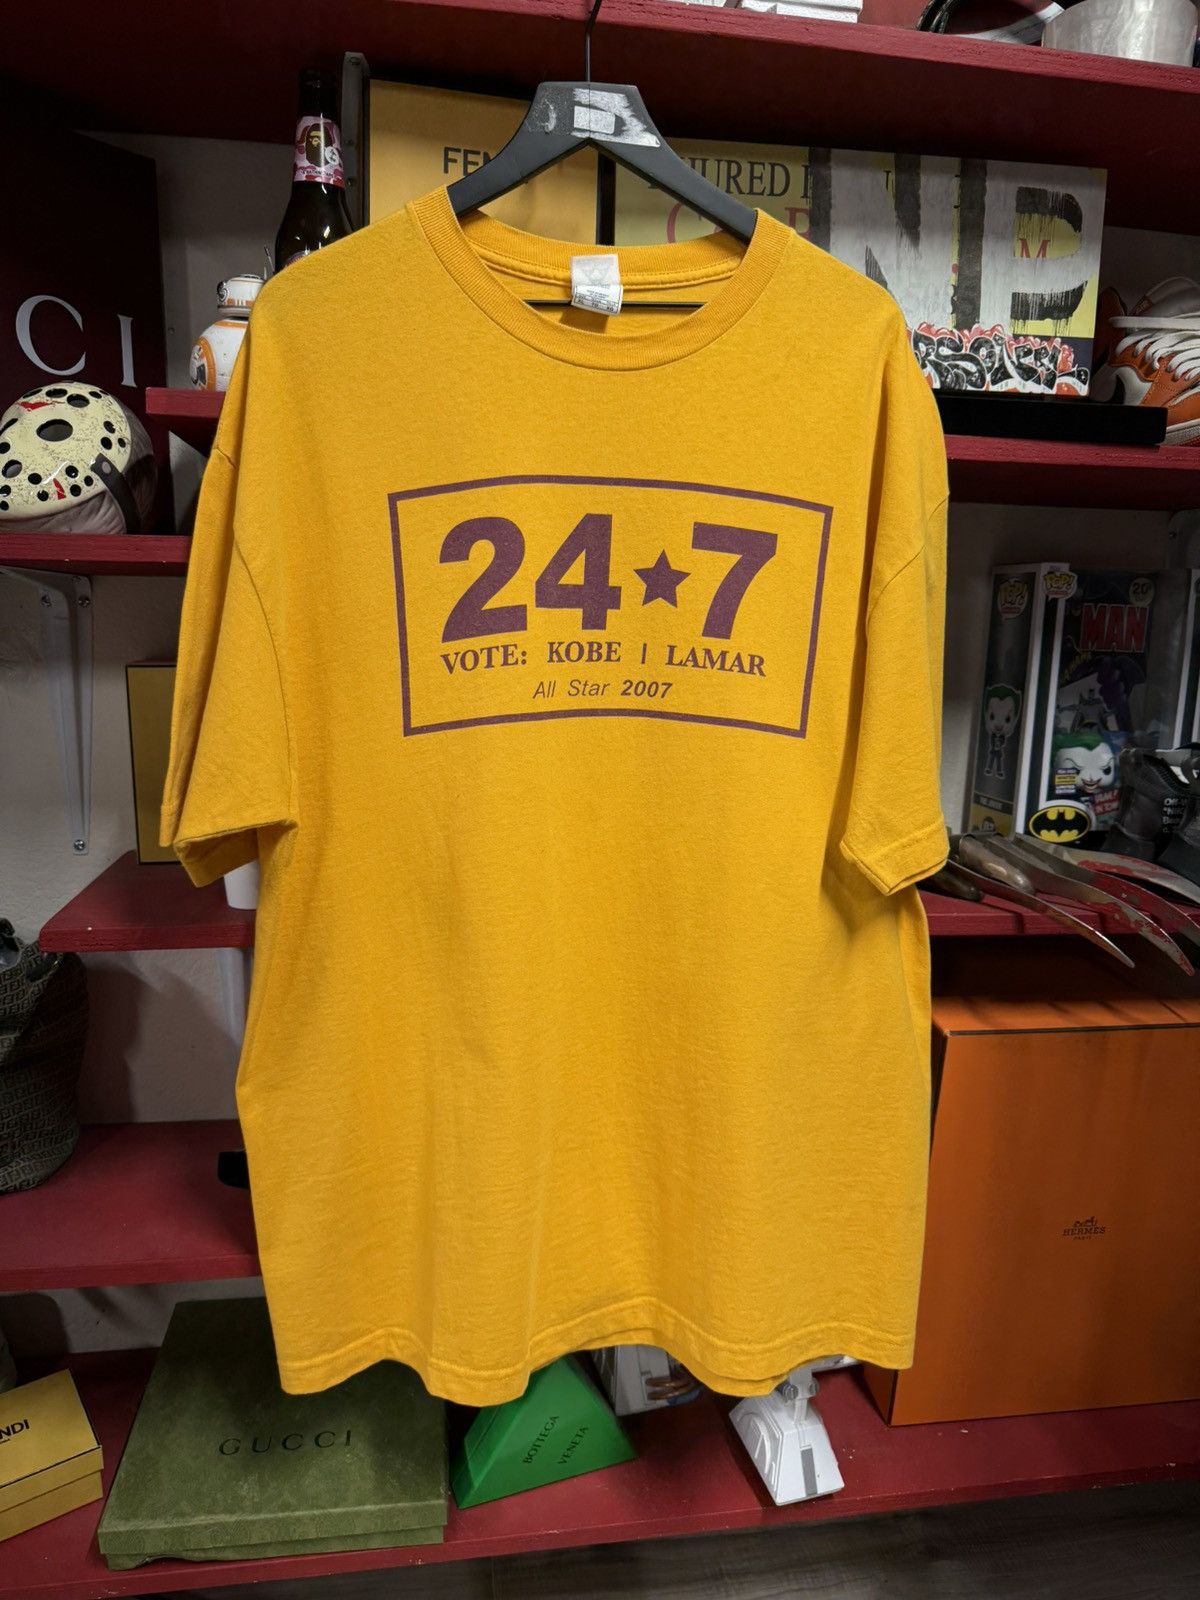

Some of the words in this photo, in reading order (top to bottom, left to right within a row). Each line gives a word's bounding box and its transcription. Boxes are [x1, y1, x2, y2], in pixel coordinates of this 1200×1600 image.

[1080, 603, 1149, 653] MAN
[440, 643, 528, 675] VOTE:
[547, 641, 622, 664] KOBE
[665, 645, 766, 677] LAMAR
[533, 680, 556, 699] All
[567, 680, 610, 697] Star
[620, 680, 673, 699] 2007
[219, 1429, 352, 1456] GUCCI
[522, 1416, 559, 1463] BOTTEGA
[557, 1427, 589, 1464] VENETA
